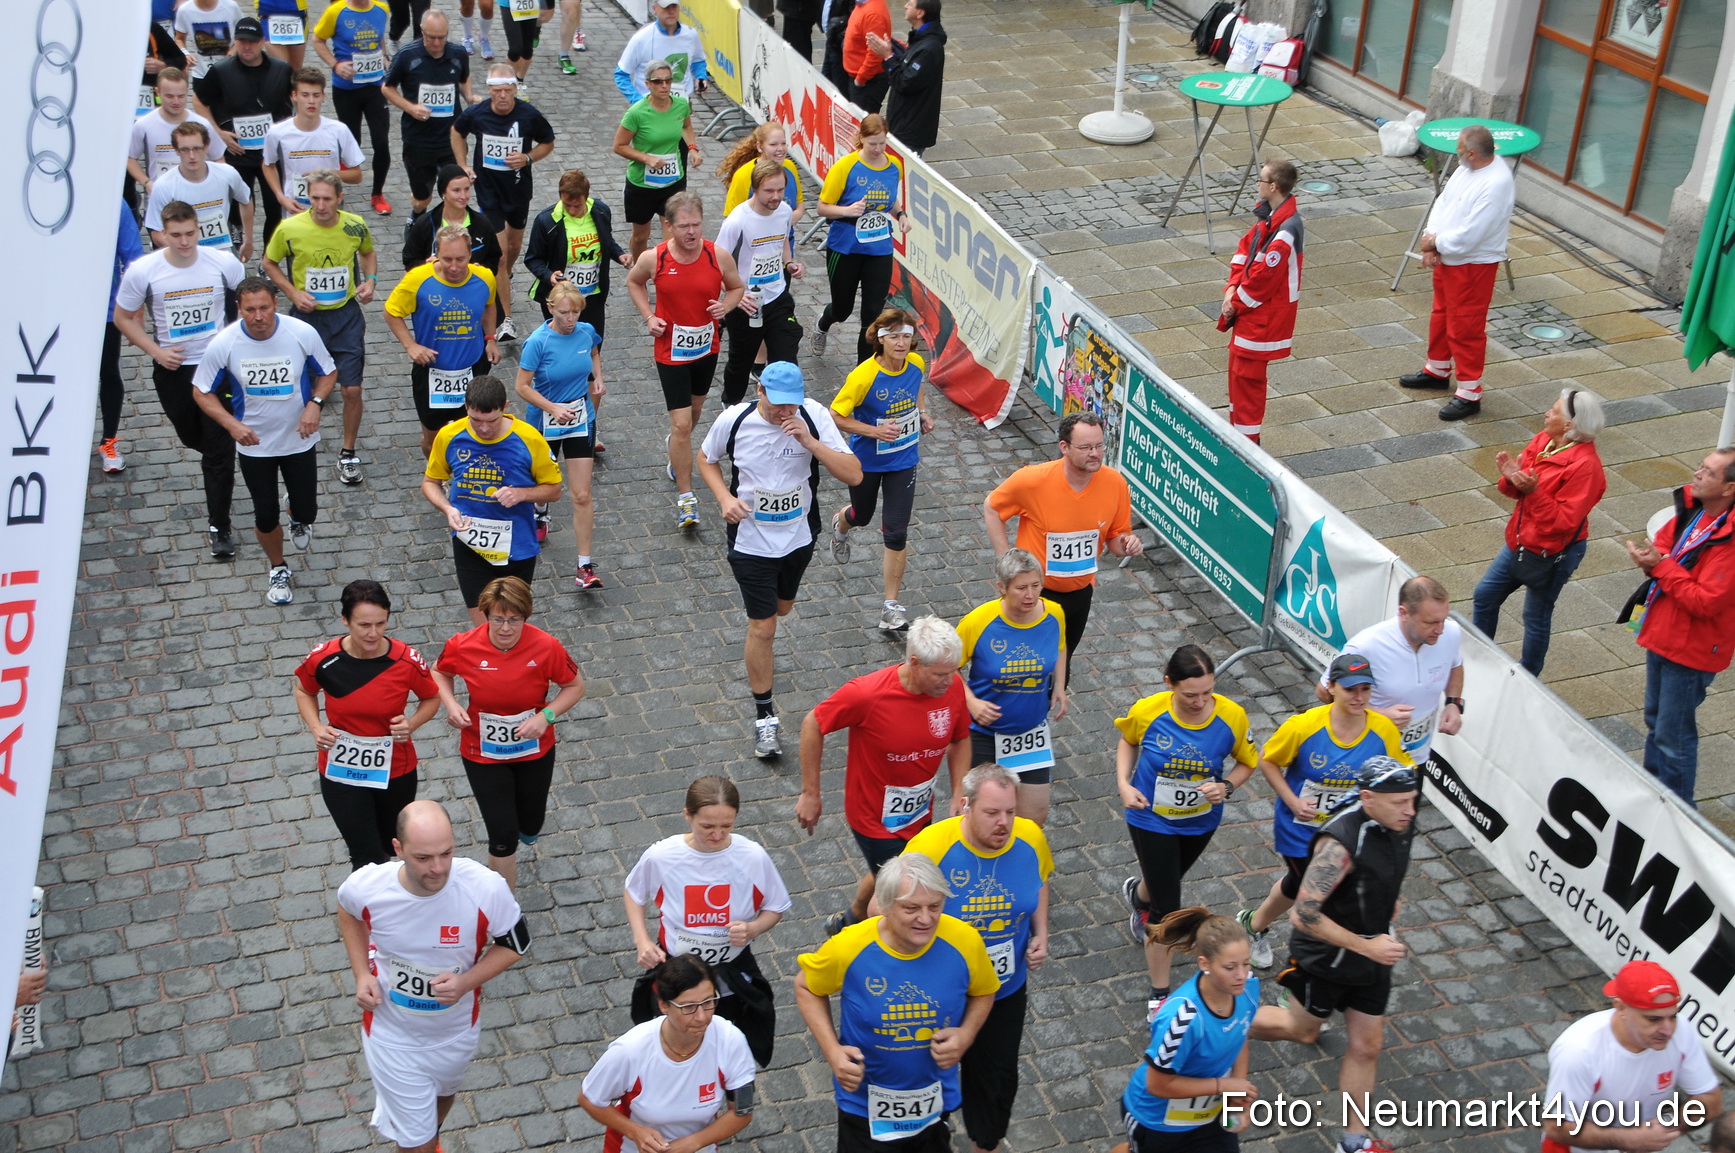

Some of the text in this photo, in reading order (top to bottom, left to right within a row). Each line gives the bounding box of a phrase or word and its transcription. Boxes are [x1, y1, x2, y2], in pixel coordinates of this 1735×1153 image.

[272, 23, 299, 34] 2867
[357, 58, 382, 73] 2426
[423, 92, 452, 105] 2034
[861, 216, 887, 230] 2839
[570, 234, 599, 245] Mülle
[754, 258, 780, 276] 2253
[310, 275, 345, 291] 3414
[568, 270, 597, 285] 2692
[182, 301, 207, 309] Neumarkt
[171, 308, 210, 327] 2297
[180, 325, 207, 335] Benedikt
[676, 333, 711, 348] 2942
[248, 367, 289, 385] 2242
[260, 387, 280, 396] Ralph
[434, 378, 468, 393] 2848
[898, 420, 916, 437] 41
[1150, 399, 1219, 467] Event-Leit-Systeme
[1128, 420, 1220, 516] Mehr Sicherheit
[755, 488, 796, 498] PARTL Neumarkt
[1126, 446, 1200, 528] für Ihr Event!
[760, 494, 800, 512] 2486
[771, 514, 789, 522] Erich
[479, 522, 504, 530] Neumarkt
[467, 529, 501, 549] 257
[1140, 497, 1147, 510] &
[1147, 503, 1172, 534] Service
[1172, 527, 1190, 551] Line:
[1190, 545, 1213, 572] 09181
[1213, 566, 1233, 591] 6352
[1052, 541, 1093, 560] 3415
[0, 321, 61, 799] Audi BKK
[486, 724, 522, 742] 236
[496, 744, 524, 753] Monika
[1001, 730, 1046, 755] 3395
[334, 744, 385, 767] 2266
[346, 769, 368, 779] Petra
[1174, 790, 1199, 807] 92
[1424, 759, 1492, 831] die verbinden
[1525, 850, 1650, 962] stadtwer
[687, 912, 728, 925] DKMS
[678, 935, 701, 947] PARTL
[391, 960, 413, 972] PARTL
[22, 928, 41, 1046] BMW sport
[408, 999, 440, 1009] Daniel
[870, 1090, 930, 1100] PARTL Neumarkt
[877, 1096, 935, 1119] 2547
[893, 1121, 922, 1131] Dieter
